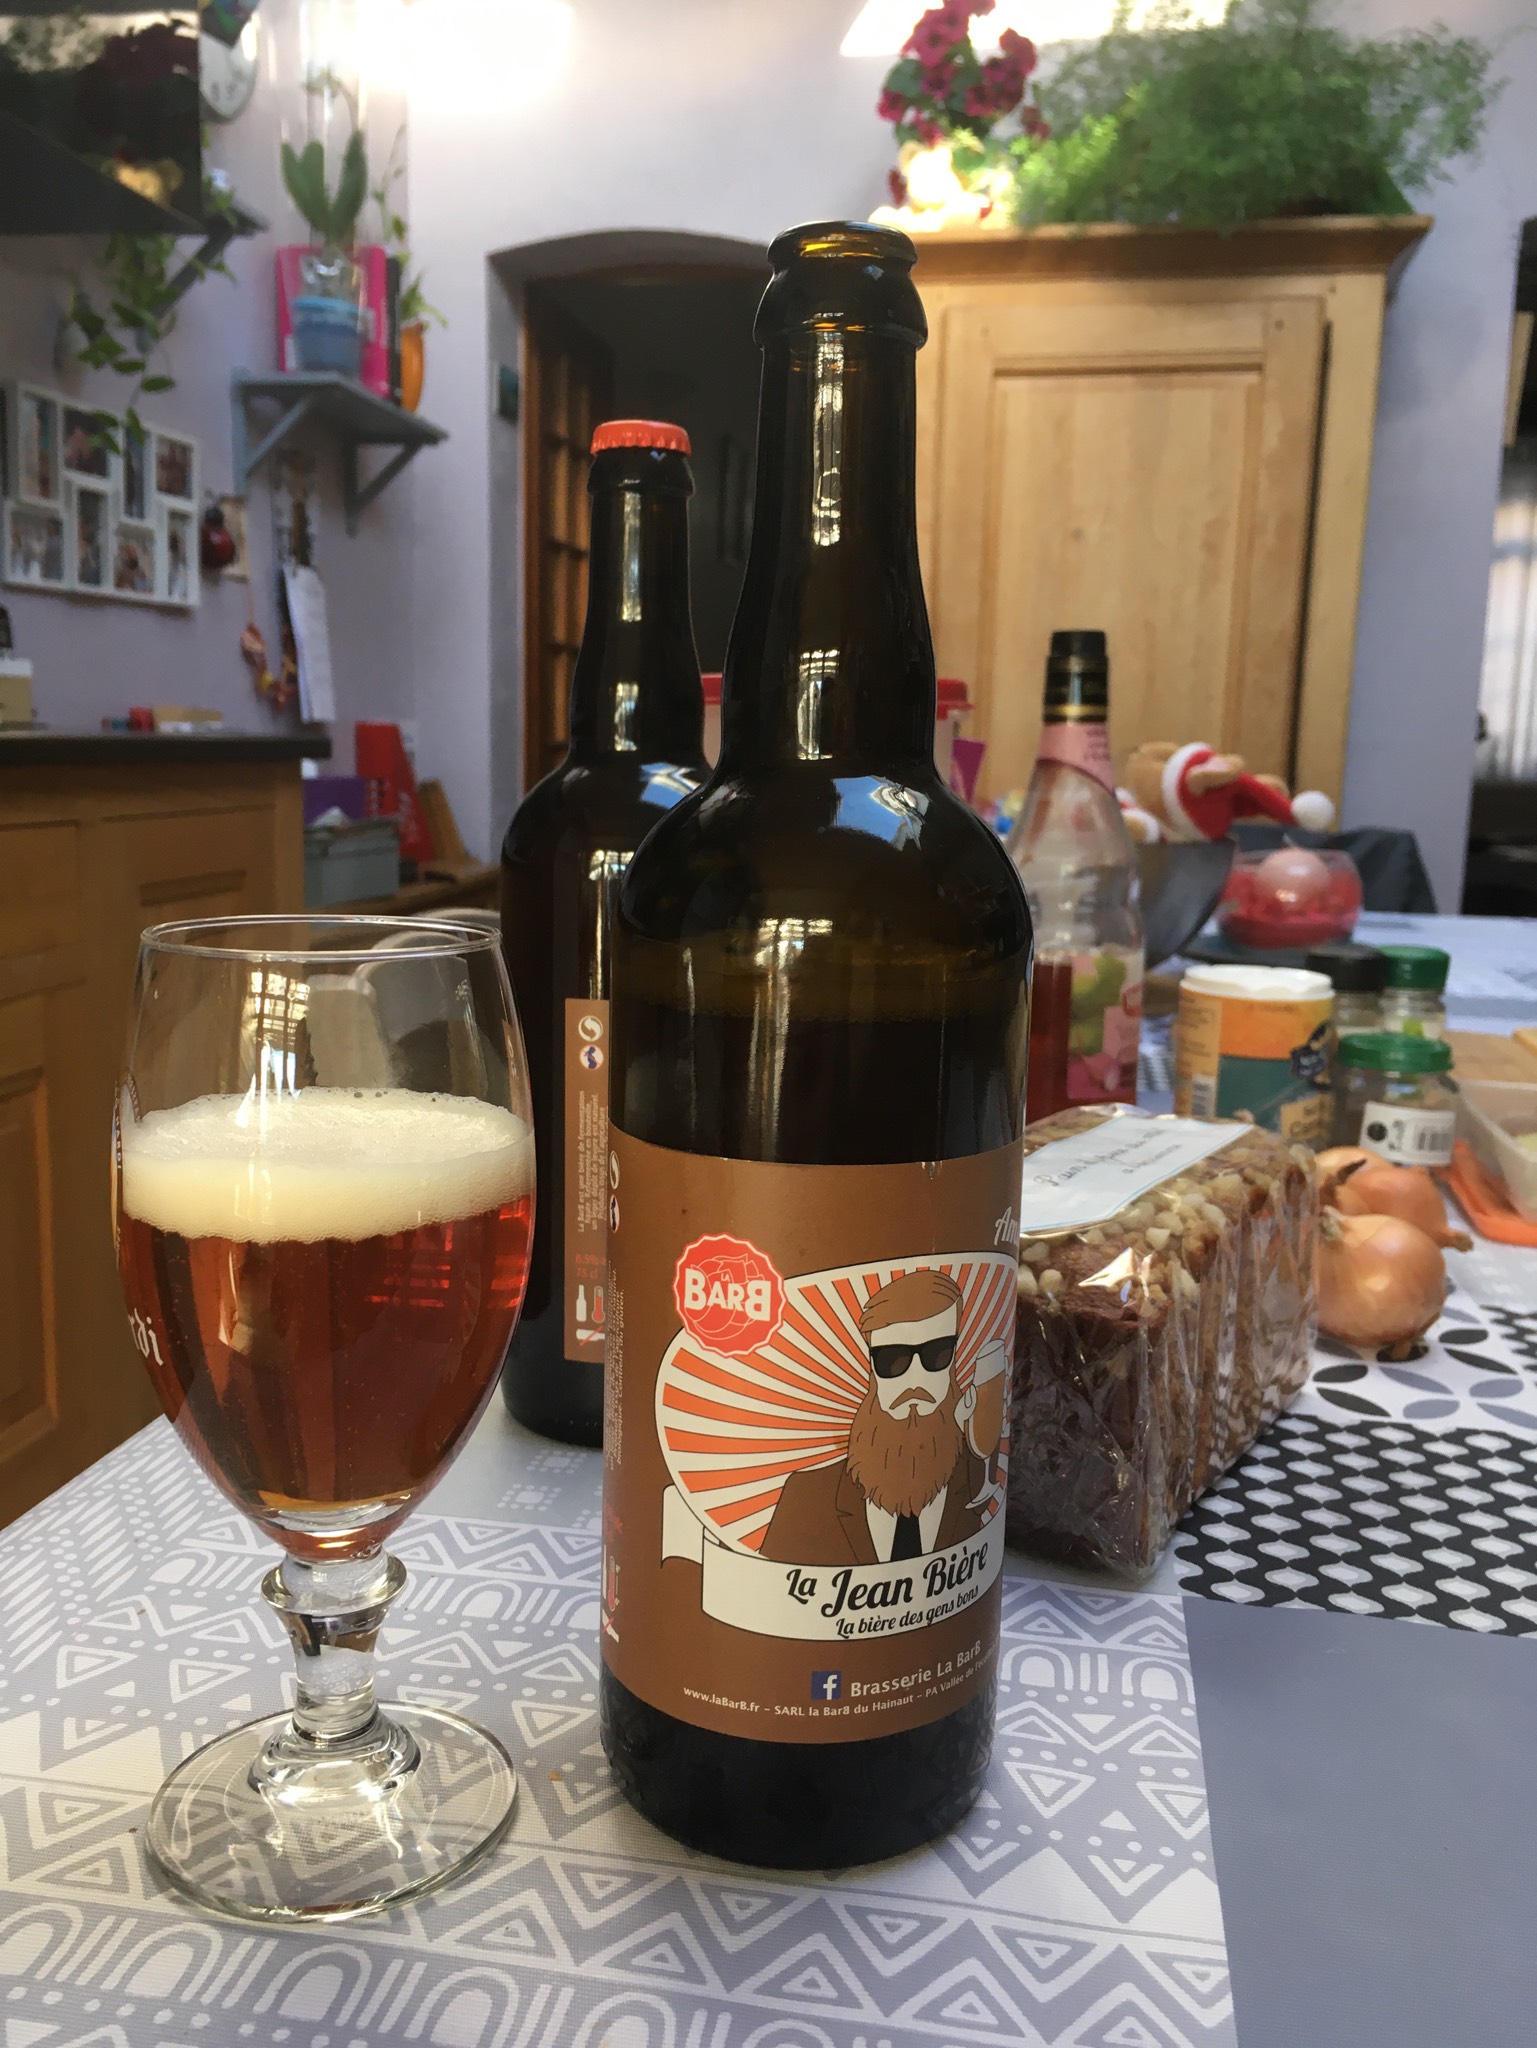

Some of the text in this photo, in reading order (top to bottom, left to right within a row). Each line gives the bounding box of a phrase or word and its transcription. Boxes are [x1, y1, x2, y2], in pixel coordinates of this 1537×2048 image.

[786, 1542, 989, 1618] La Jean Bière
[836, 1585, 979, 1640] La bière des gens bons
[683, 1686, 760, 1713] www.laBarB.fr
[774, 1705, 805, 1717] SARL
[809, 1706, 820, 1717] la
[853, 1704, 869, 1714] du
[872, 1694, 914, 1712] Hainaut
[925, 1685, 938, 1698] PA
[940, 1674, 964, 1691] Vallée
[965, 1667, 974, 1678] de
[850, 1667, 932, 1698] Brasserie
[937, 1661, 952, 1678] La
